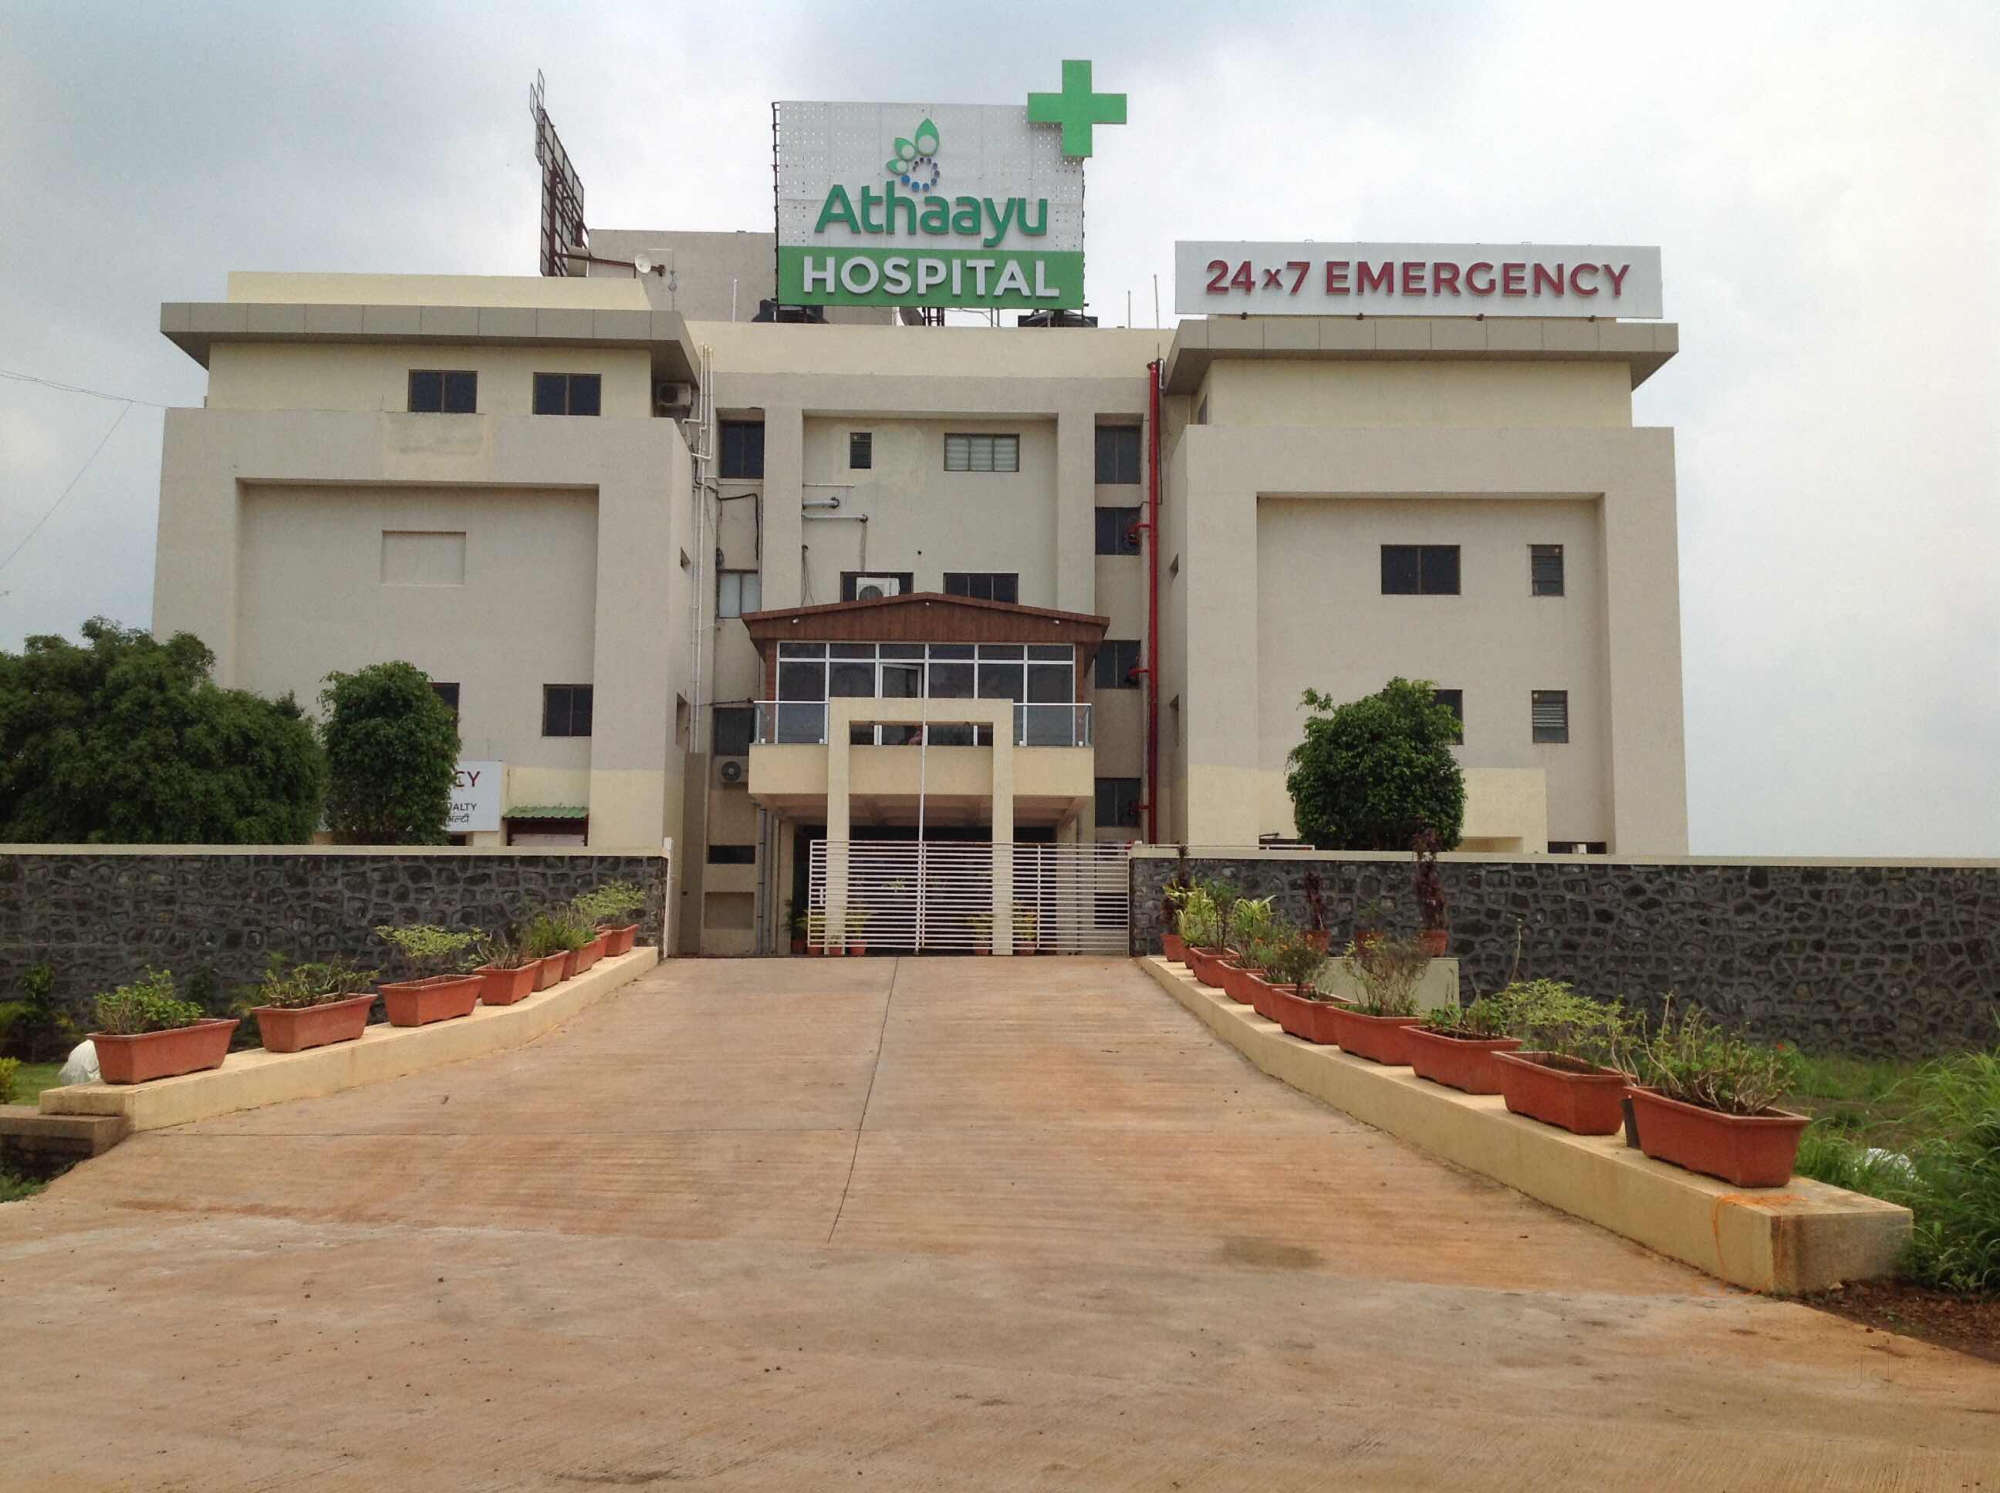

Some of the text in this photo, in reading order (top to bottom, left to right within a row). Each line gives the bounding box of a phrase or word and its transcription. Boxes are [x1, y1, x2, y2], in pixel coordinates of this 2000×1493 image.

[814, 180, 1048, 248] Athaayu
[802, 255, 1060, 298] HOSPITAL
[1325, 261, 1631, 298] EMERGENCY
